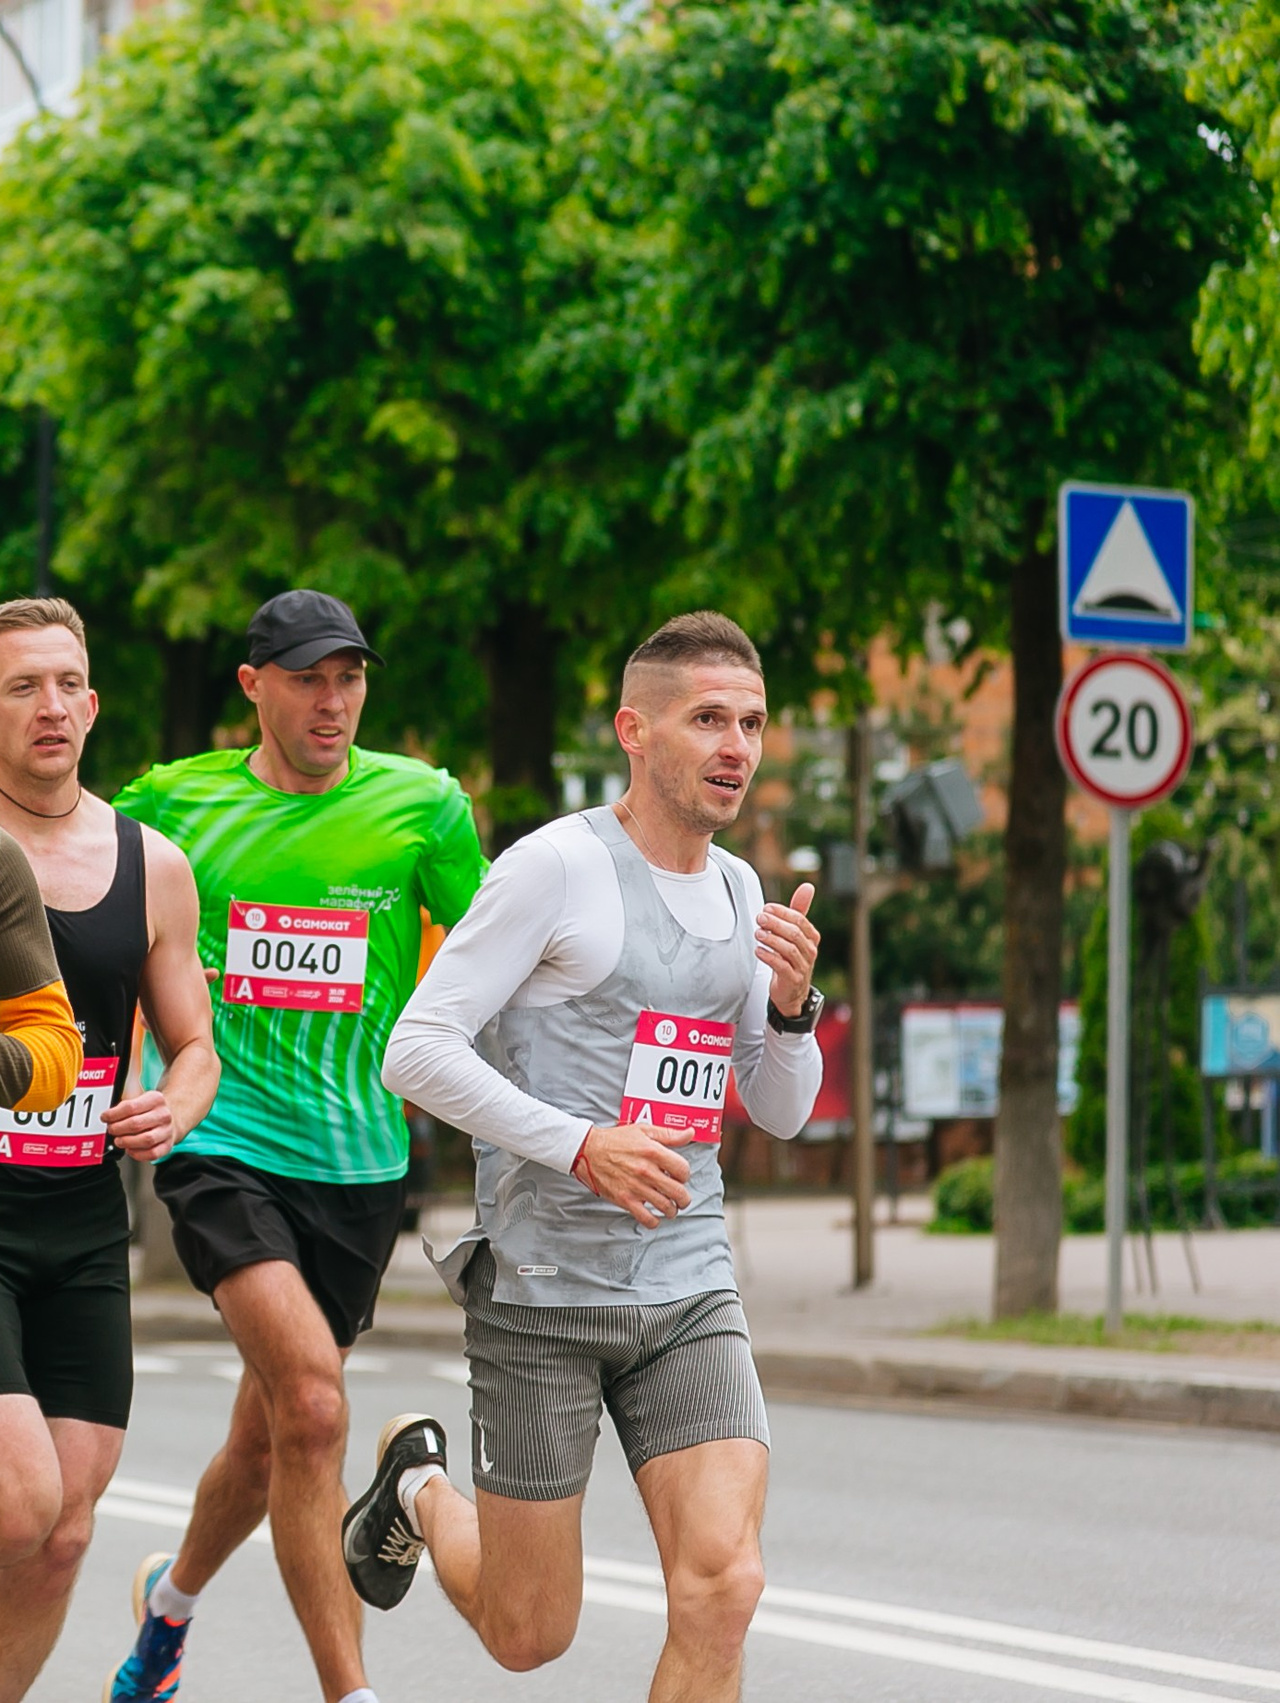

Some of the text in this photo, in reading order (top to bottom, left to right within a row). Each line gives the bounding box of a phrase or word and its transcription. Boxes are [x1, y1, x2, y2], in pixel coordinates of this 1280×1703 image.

[1088, 699, 1160, 763] 20
[251, 912, 261, 922] 10
[251, 938, 342, 975] 0040
[662, 1025, 672, 1036] 10
[656, 1056, 725, 1101] 0013
